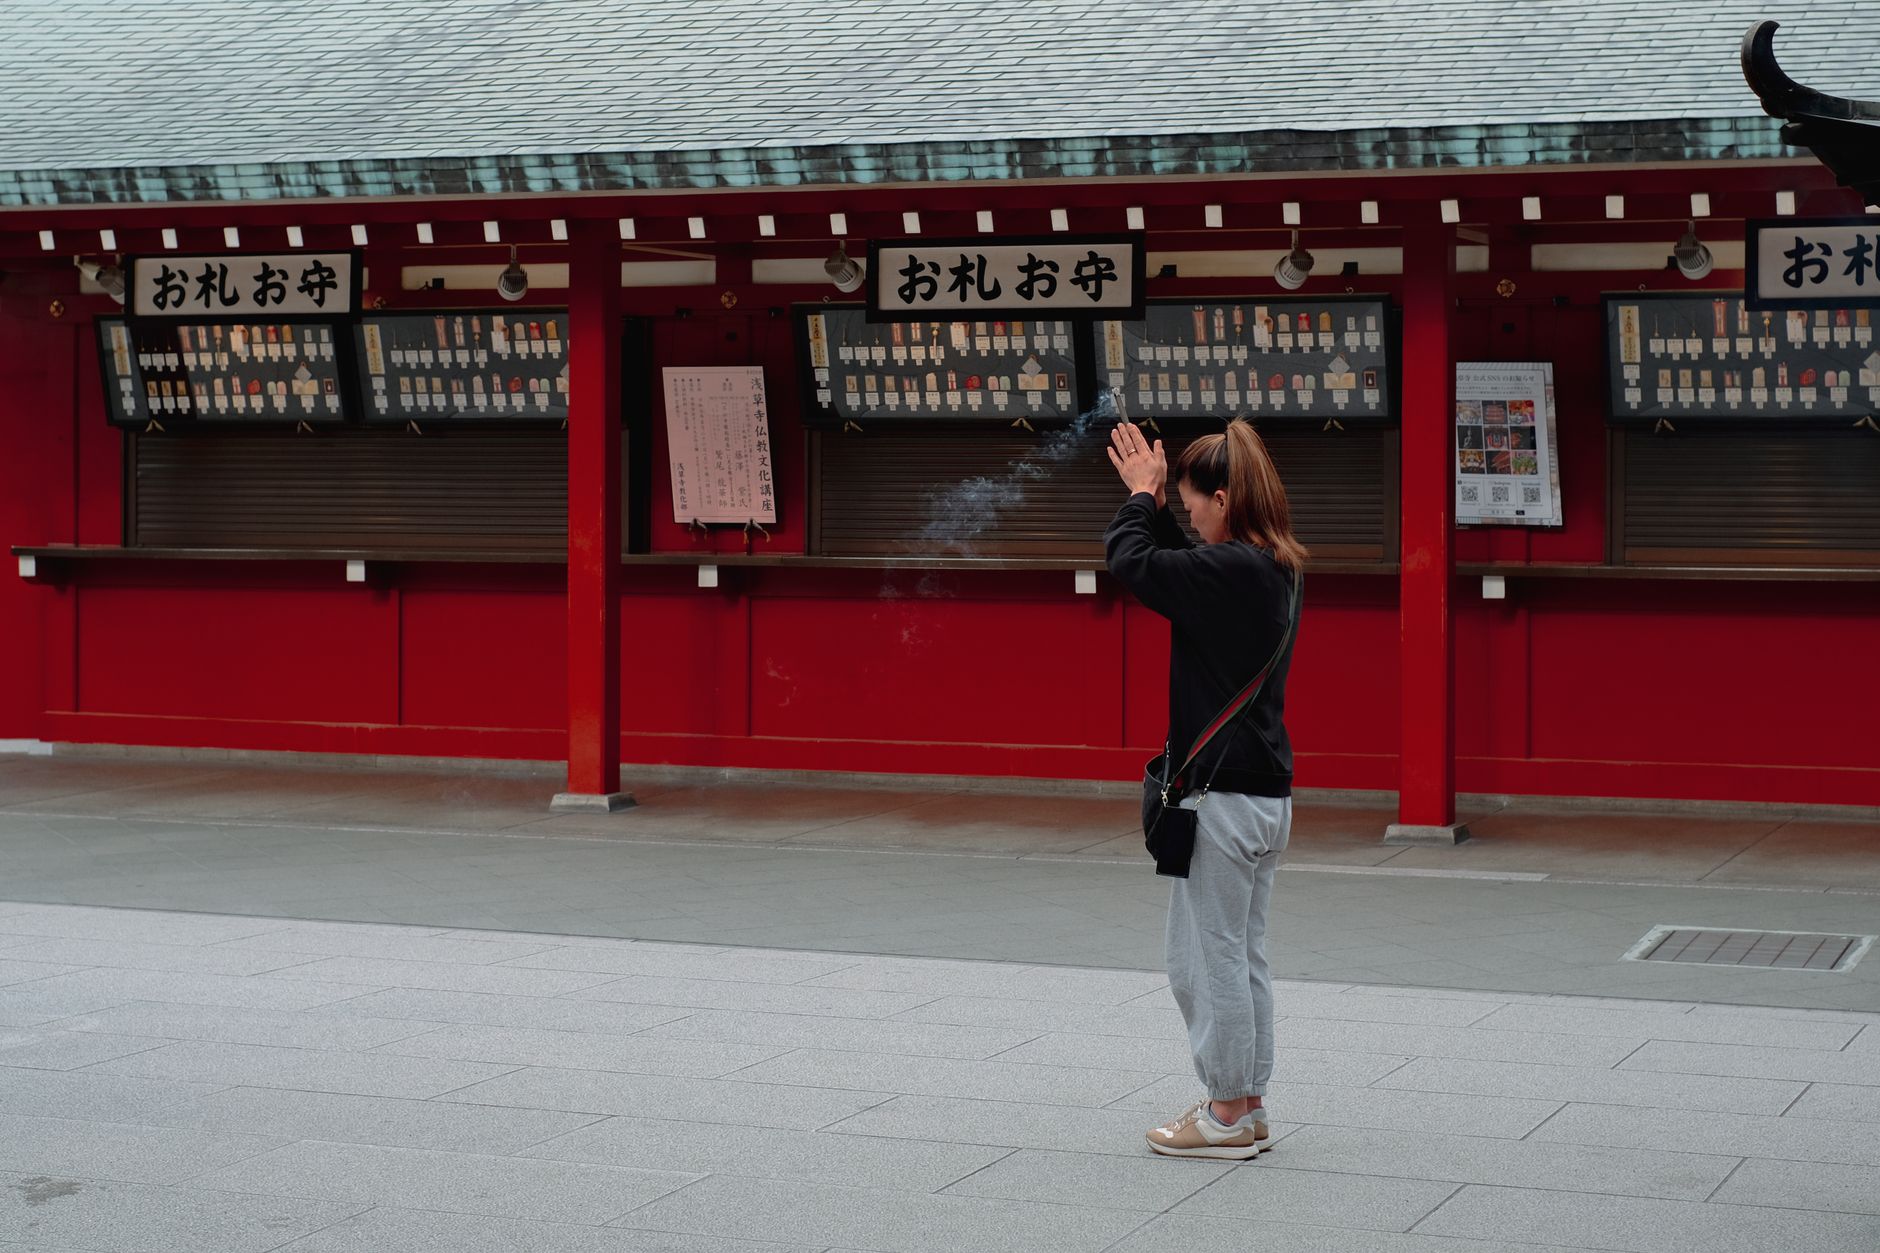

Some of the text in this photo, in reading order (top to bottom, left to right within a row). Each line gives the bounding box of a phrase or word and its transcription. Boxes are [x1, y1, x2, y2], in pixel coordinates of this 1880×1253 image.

[151, 258, 339, 311] お札お守
[896, 249, 1119, 305] お札お守
[751, 377, 773, 512] 浅草寺仏教文化講座
